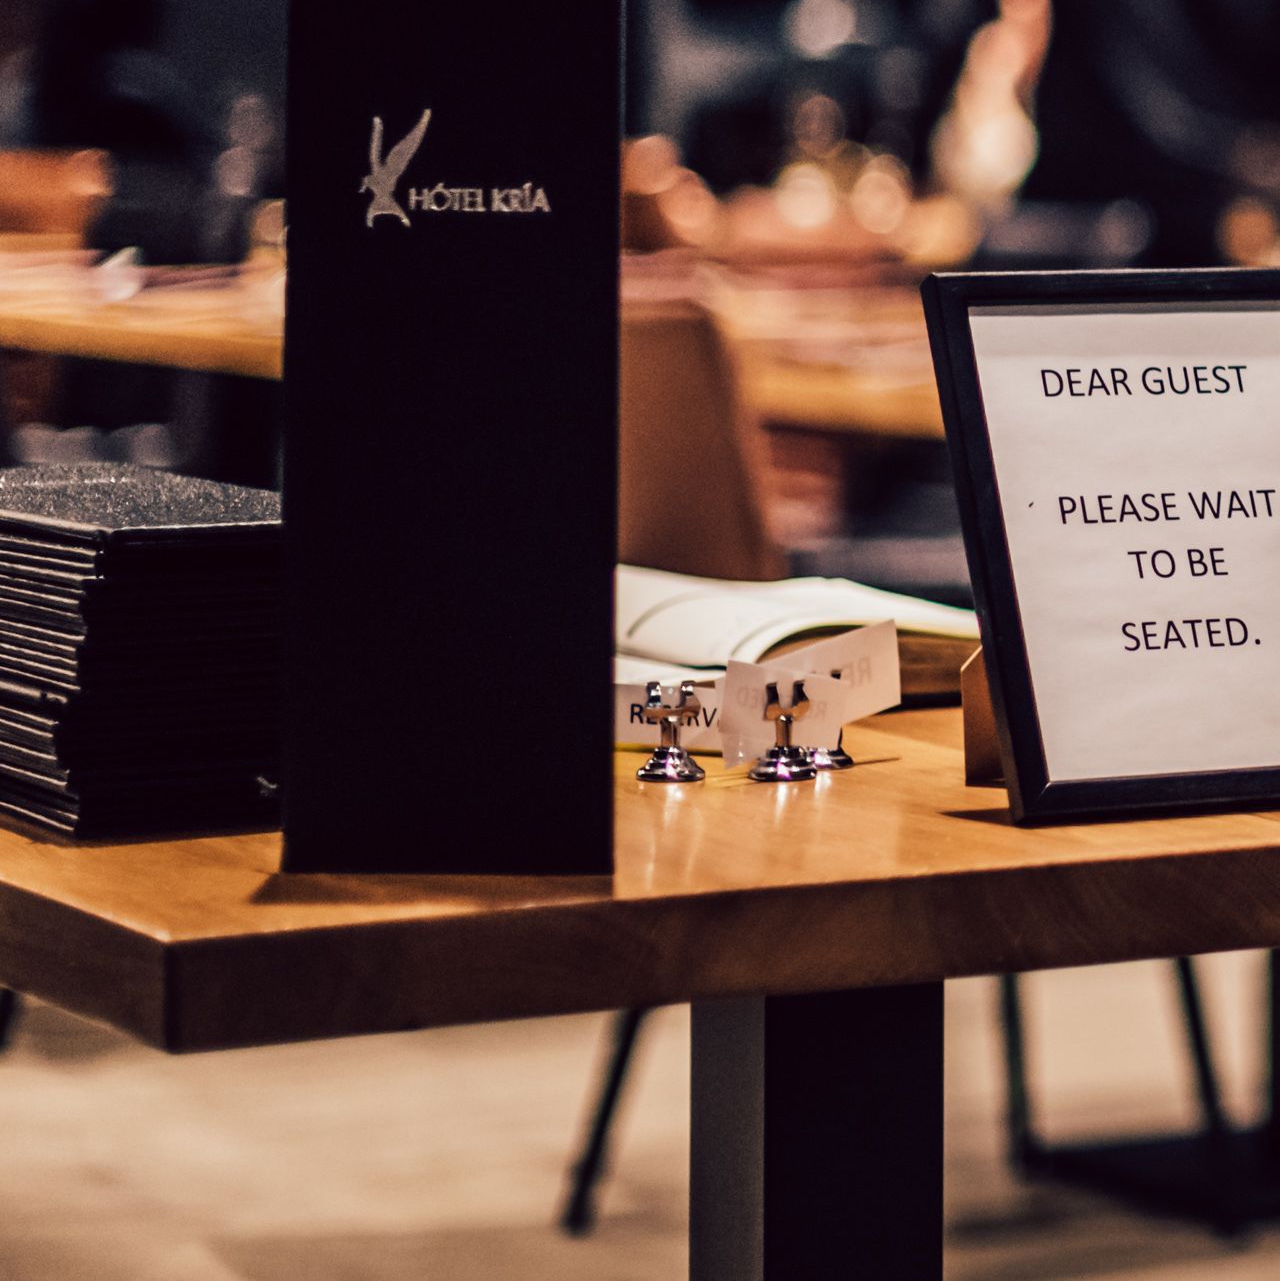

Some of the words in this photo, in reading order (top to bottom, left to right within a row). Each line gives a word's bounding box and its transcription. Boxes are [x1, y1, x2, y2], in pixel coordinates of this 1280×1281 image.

[408, 182, 487, 212] HÓTEL
[491, 181, 551, 212] KRÍA
[1041, 368, 1132, 397] DEAR
[1141, 365, 1247, 395] GUEST
[1058, 492, 1180, 524] PLEASE
[1188, 489, 1276, 519] WAIT
[1127, 549, 1176, 579] TO
[1187, 547, 1229, 577] BE
[1121, 618, 1261, 651] SEATED.
